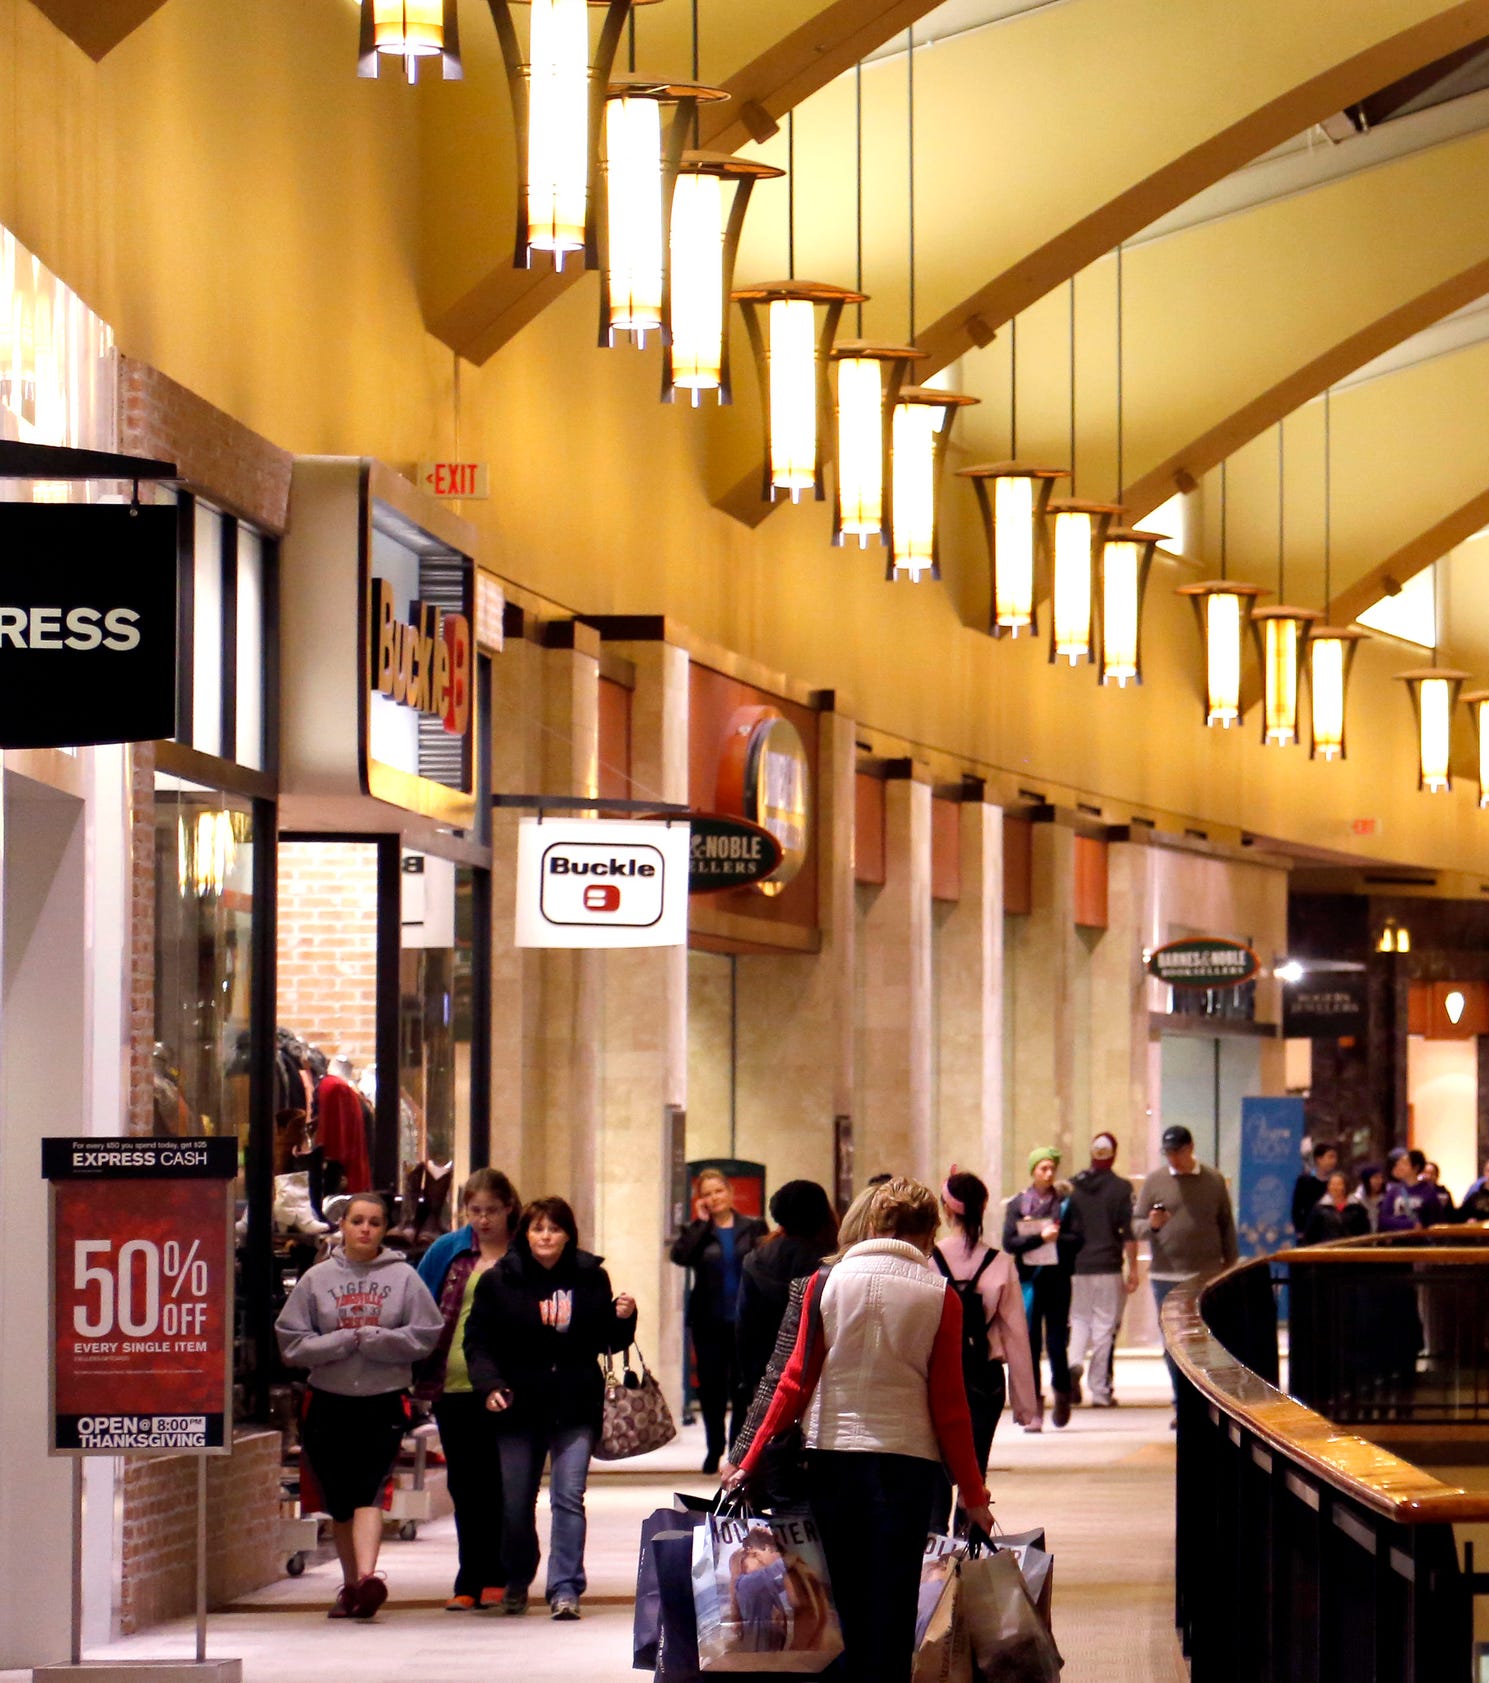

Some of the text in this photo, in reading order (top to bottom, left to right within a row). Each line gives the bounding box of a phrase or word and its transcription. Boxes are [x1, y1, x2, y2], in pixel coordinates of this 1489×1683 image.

[435, 464, 477, 494] EXIT
[372, 578, 450, 718] Buckle
[706, 836, 762, 859] NOBLE
[550, 857, 655, 877] Buckle
[86, 1143, 104, 1151] every
[121, 1142, 134, 1151] you
[135, 1141, 157, 1151] spend
[180, 1141, 192, 1150] get
[72, 1152, 207, 1166] EXPRESS CASH
[73, 1239, 207, 1337] 50%
[163, 1303, 207, 1335] OFF
[74, 1341, 207, 1353] EVERY SINGLE ITEM
[77, 1416, 137, 1434] OPEN
[79, 1434, 206, 1448] THANKSGIVING
